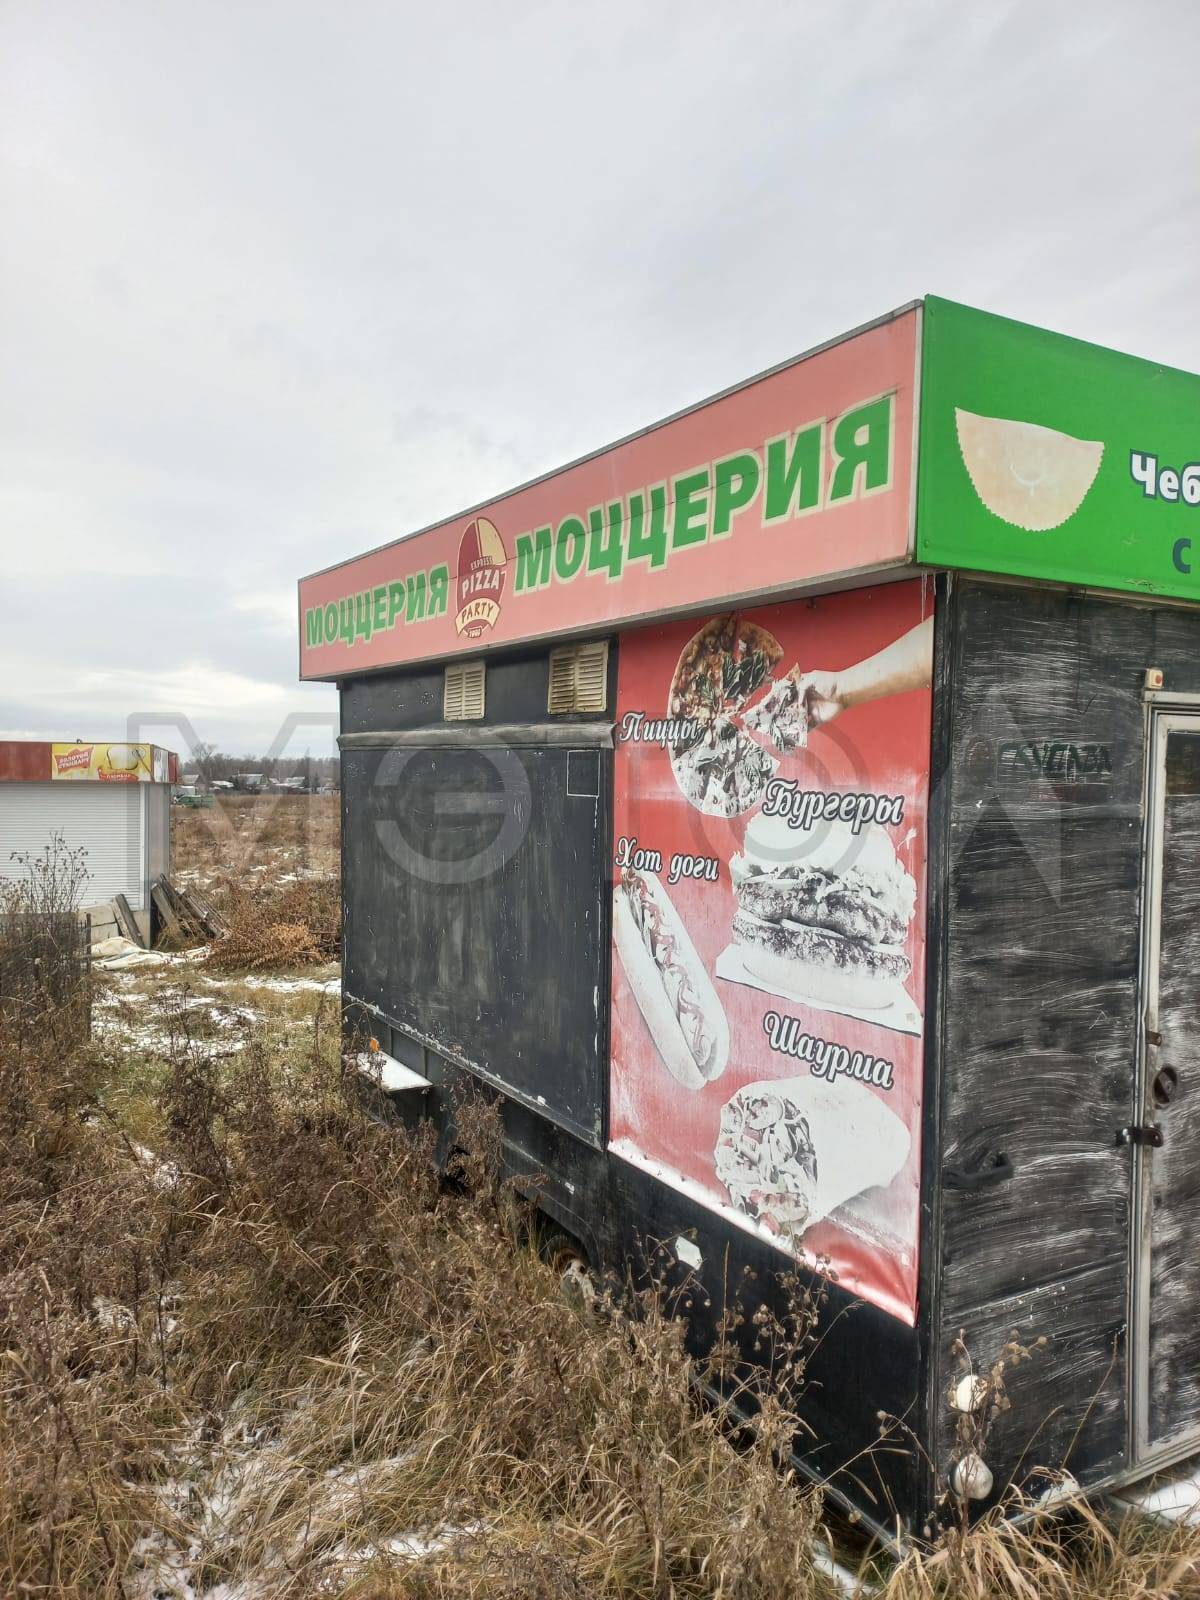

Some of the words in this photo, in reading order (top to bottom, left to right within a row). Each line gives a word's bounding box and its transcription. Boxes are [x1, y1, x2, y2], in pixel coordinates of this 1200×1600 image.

[513, 390, 899, 596] МОЦЦЕРИЯ
[304, 563, 449, 649] МОЦЦЕРИЯ
[461, 569, 499, 599] PIZZA
[461, 602, 494, 624] PARTY
[619, 711, 699, 750] Пиццы
[763, 778, 905, 835] Бургеры
[615, 837, 662, 872] Хот
[668, 854, 719, 884] доги
[763, 1011, 894, 1090] Шаурма
